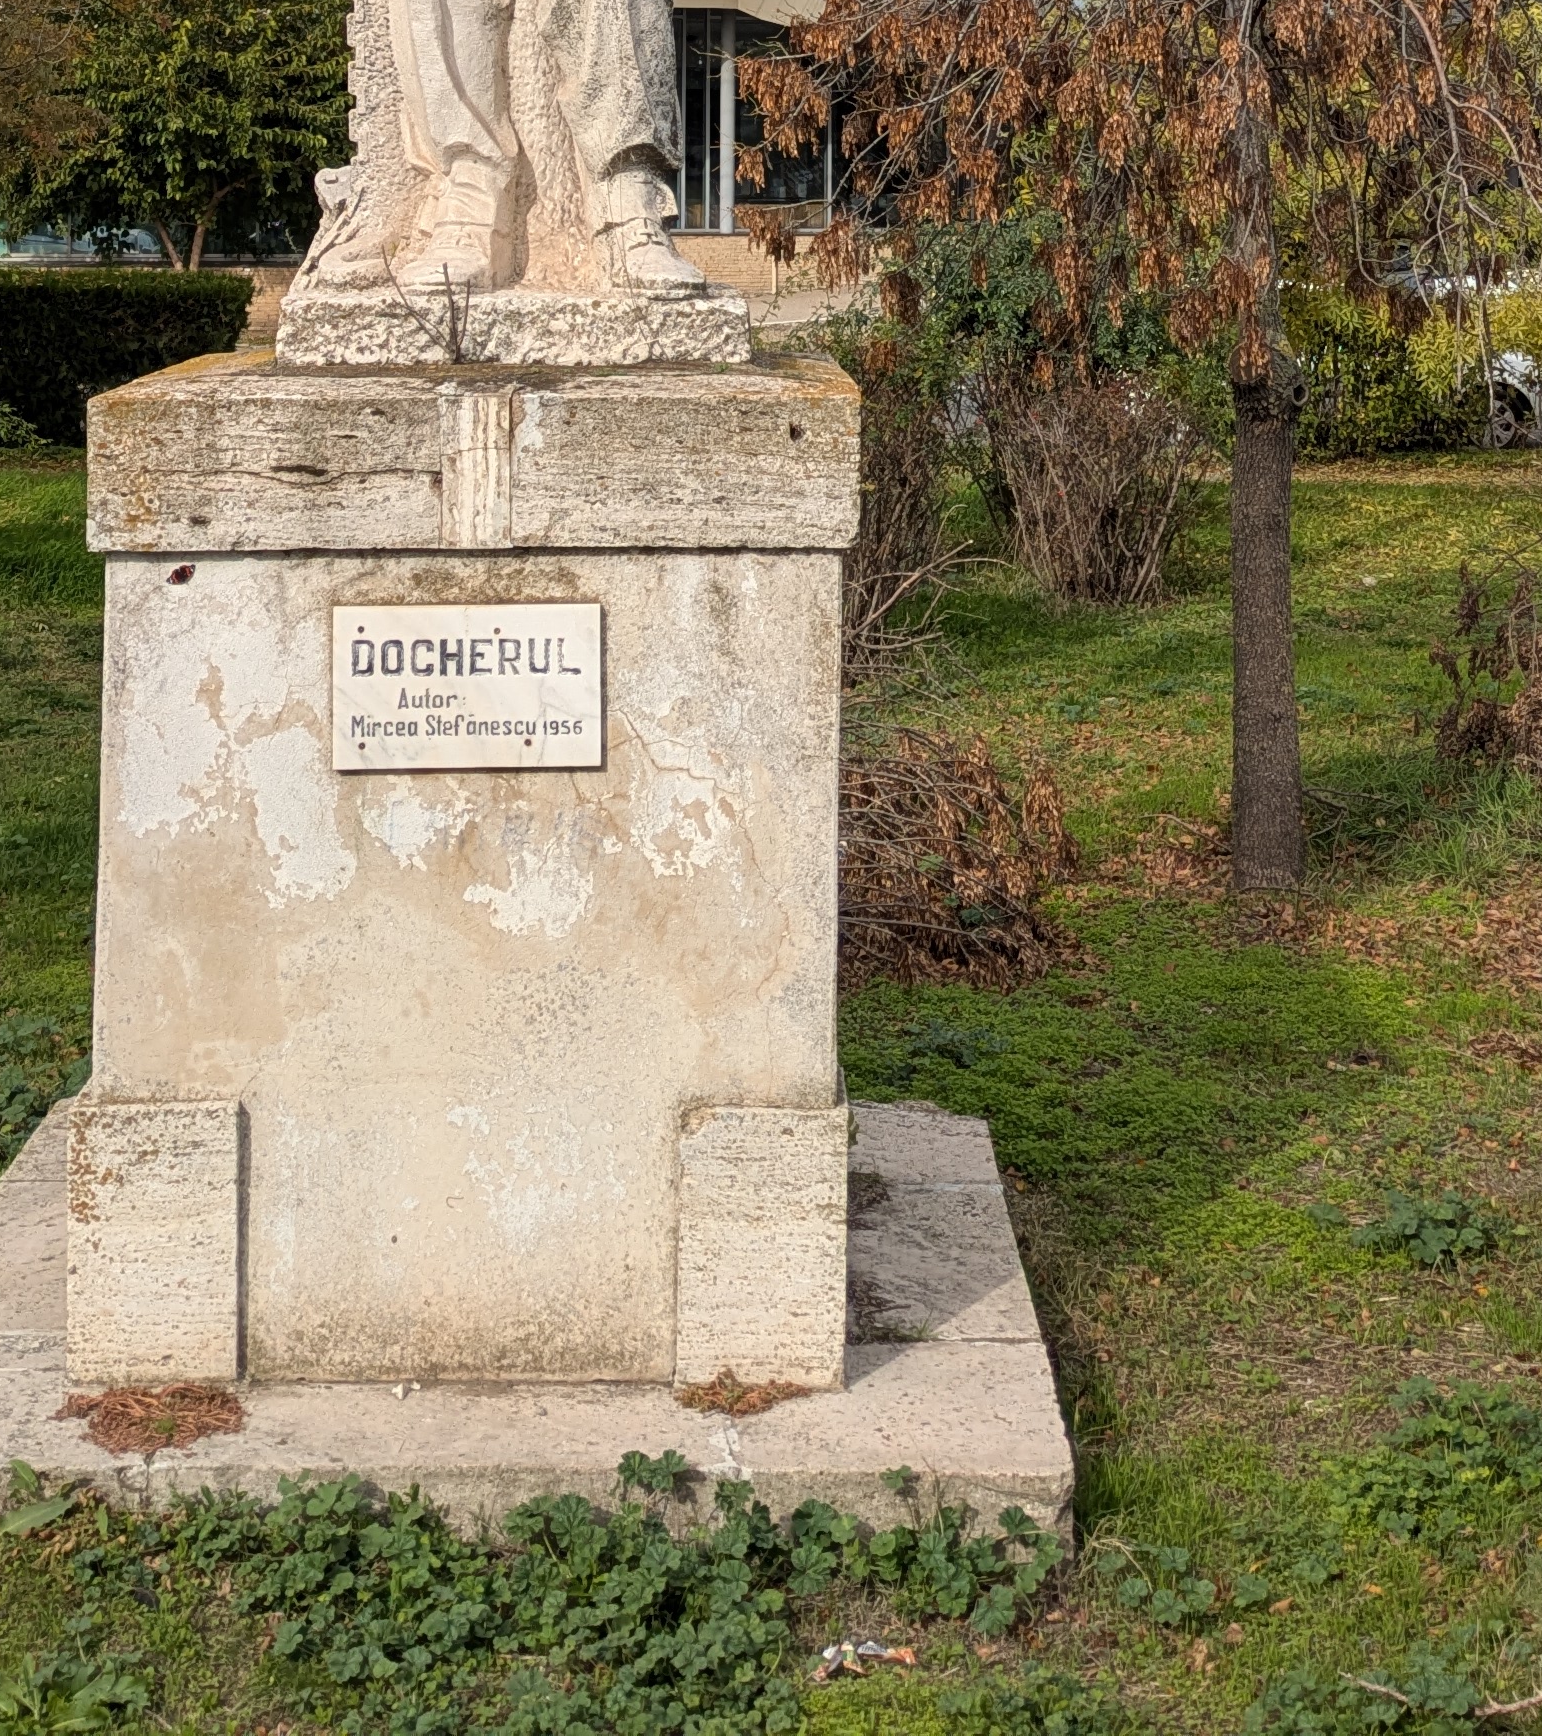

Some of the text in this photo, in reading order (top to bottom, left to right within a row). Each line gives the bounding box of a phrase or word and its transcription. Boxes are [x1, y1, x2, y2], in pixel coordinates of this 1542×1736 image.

[350, 637, 582, 677] DOCHERUL
[351, 715, 418, 738] Mircea
[543, 720, 583, 736] 1956
